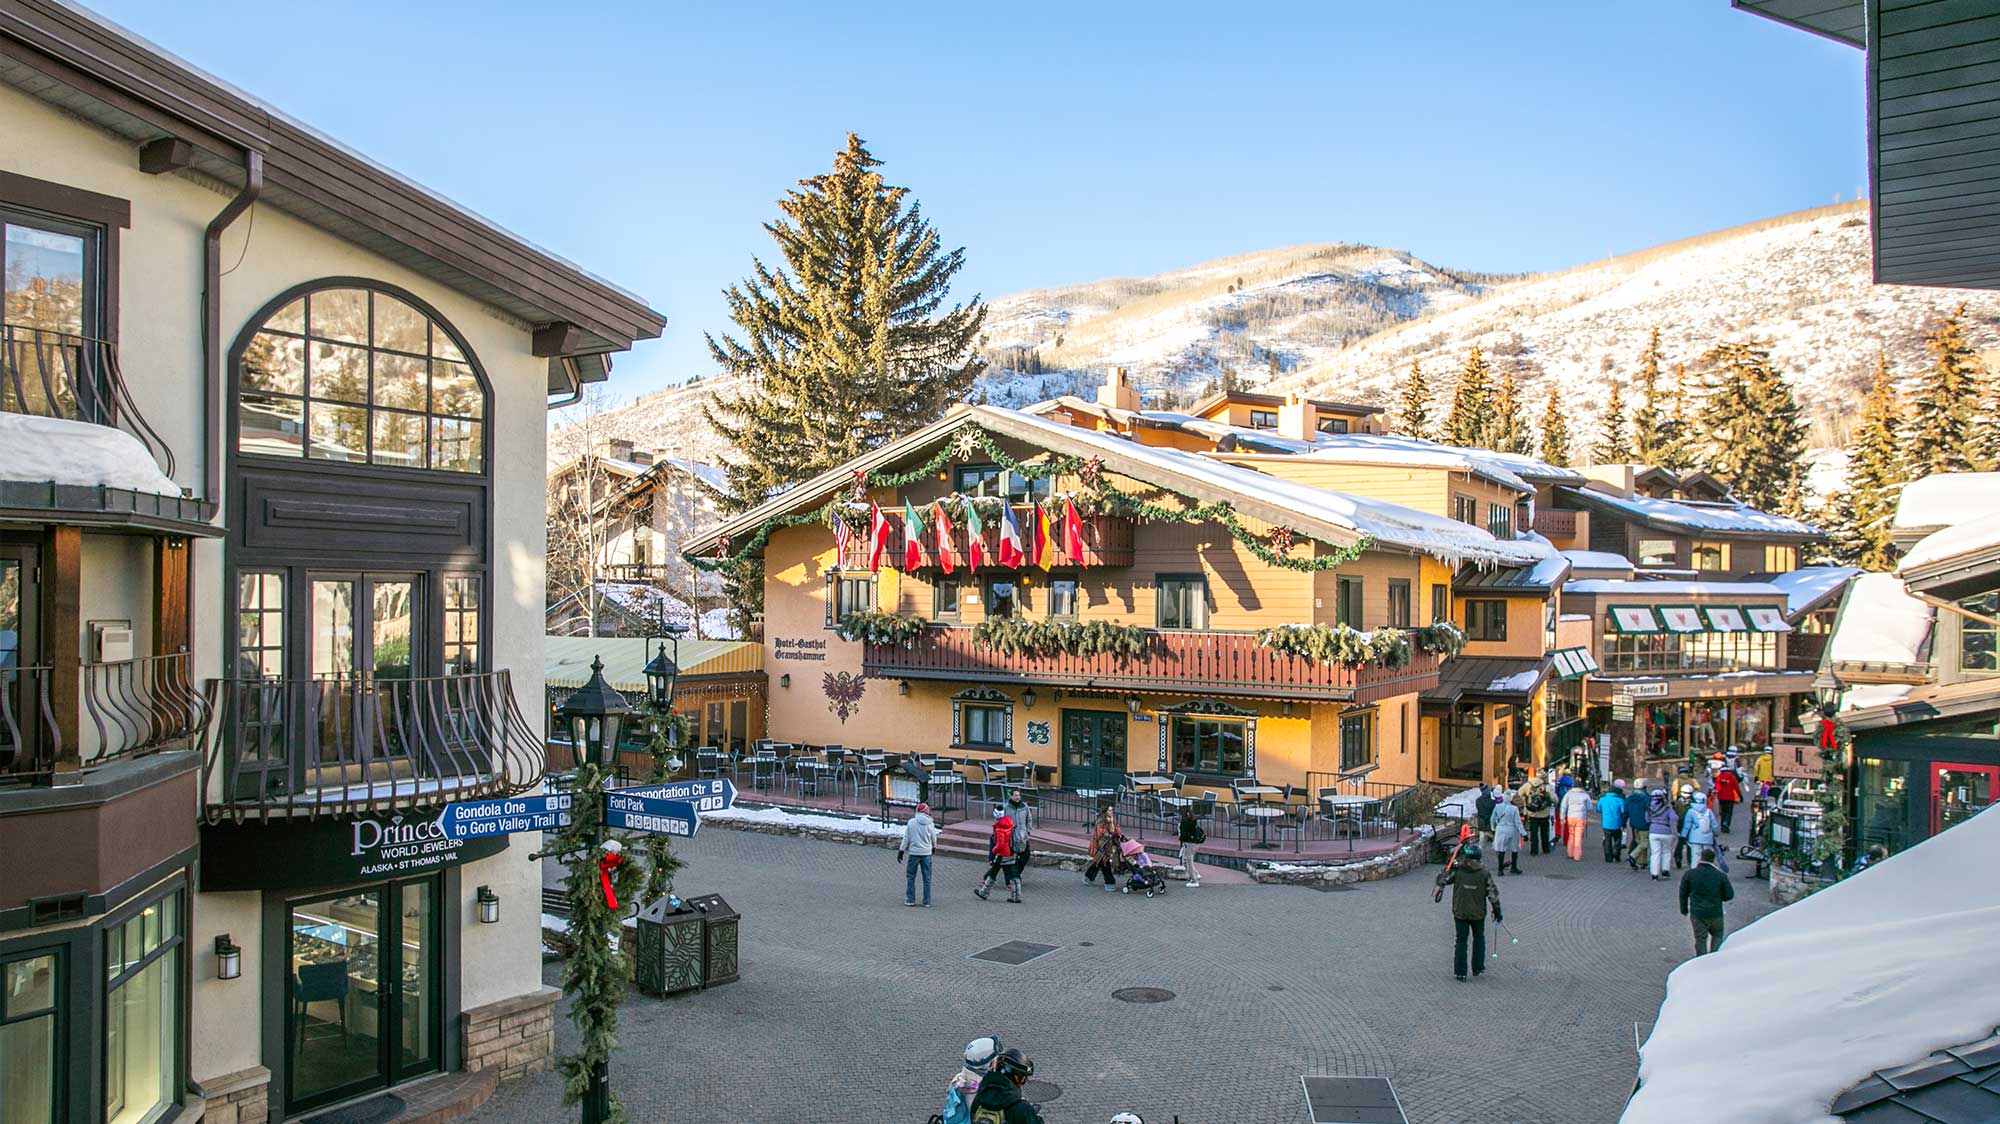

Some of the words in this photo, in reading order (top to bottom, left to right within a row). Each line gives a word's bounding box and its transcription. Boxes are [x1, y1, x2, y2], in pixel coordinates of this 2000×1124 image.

[619, 785, 690, 799] sportation
[692, 784, 706, 795] Ctr
[455, 803, 501, 819] Gondola
[504, 801, 526, 815] One
[610, 796, 626, 809] Ford
[627, 798, 645, 812] Park
[455, 823, 467, 836] to
[470, 820, 496, 834] Gore
[498, 816, 531, 833] Valley
[532, 813, 555, 828] Trail
[351, 816, 443, 856] Prince
[381, 845, 418, 860] WORLD
[421, 838, 464, 854] JEWELERS
[360, 863, 394, 875] ALASKA
[399, 860, 410, 870] ST
[411, 856, 441, 868] THOMAS
[444, 852, 458, 861] VAIL
